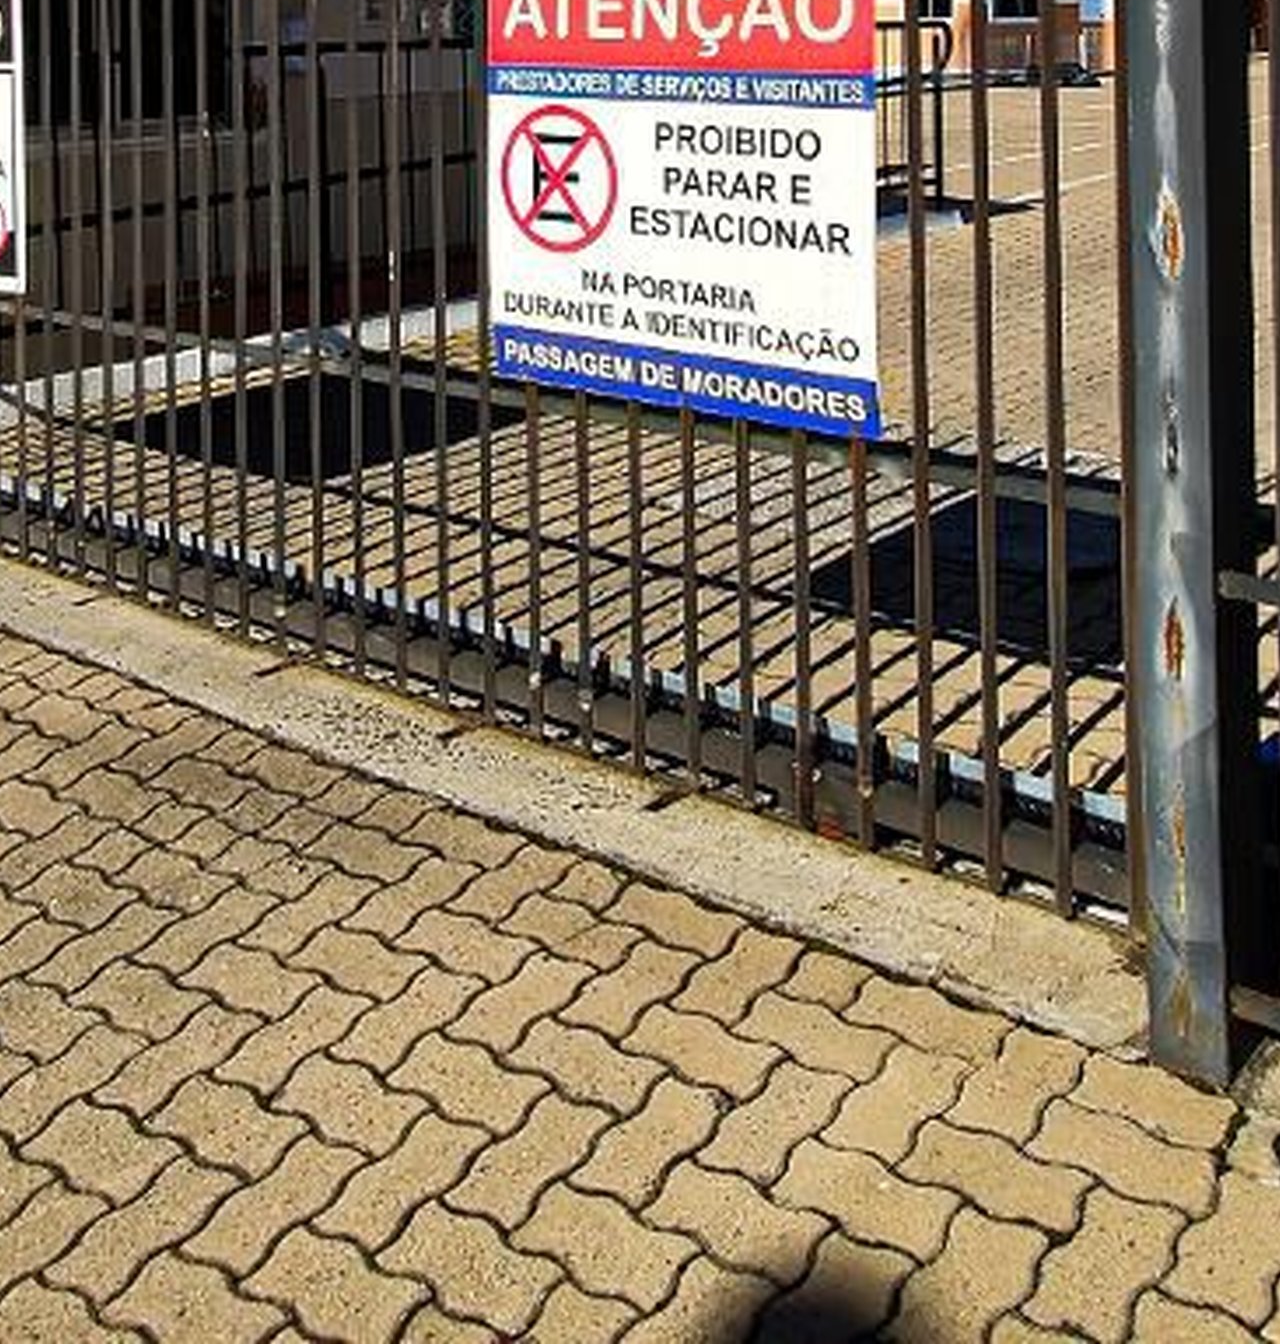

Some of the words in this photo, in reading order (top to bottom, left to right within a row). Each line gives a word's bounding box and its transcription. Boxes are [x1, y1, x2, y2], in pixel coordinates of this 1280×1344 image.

[496, 73, 611, 94] PRESTADORES
[616, 73, 641, 95] DE
[643, 76, 732, 100] SERVIÇOS
[736, 77, 748, 98] E
[751, 78, 864, 102] VISITANTES
[655, 122, 821, 160] PROIBIDO
[663, 167, 778, 204] PARAR
[792, 174, 812, 205] E
[631, 206, 851, 255] ESTACIONAR
[581, 270, 616, 295] NA
[624, 275, 756, 314] PORTARIA
[504, 291, 614, 328] DURANTE
[621, 309, 639, 330] A
[646, 310, 860, 362] IDENTIFICAÇÃO
[504, 341, 637, 381] PASSAGEM
[642, 363, 678, 390] DE
[684, 367, 867, 421] MORADORES
